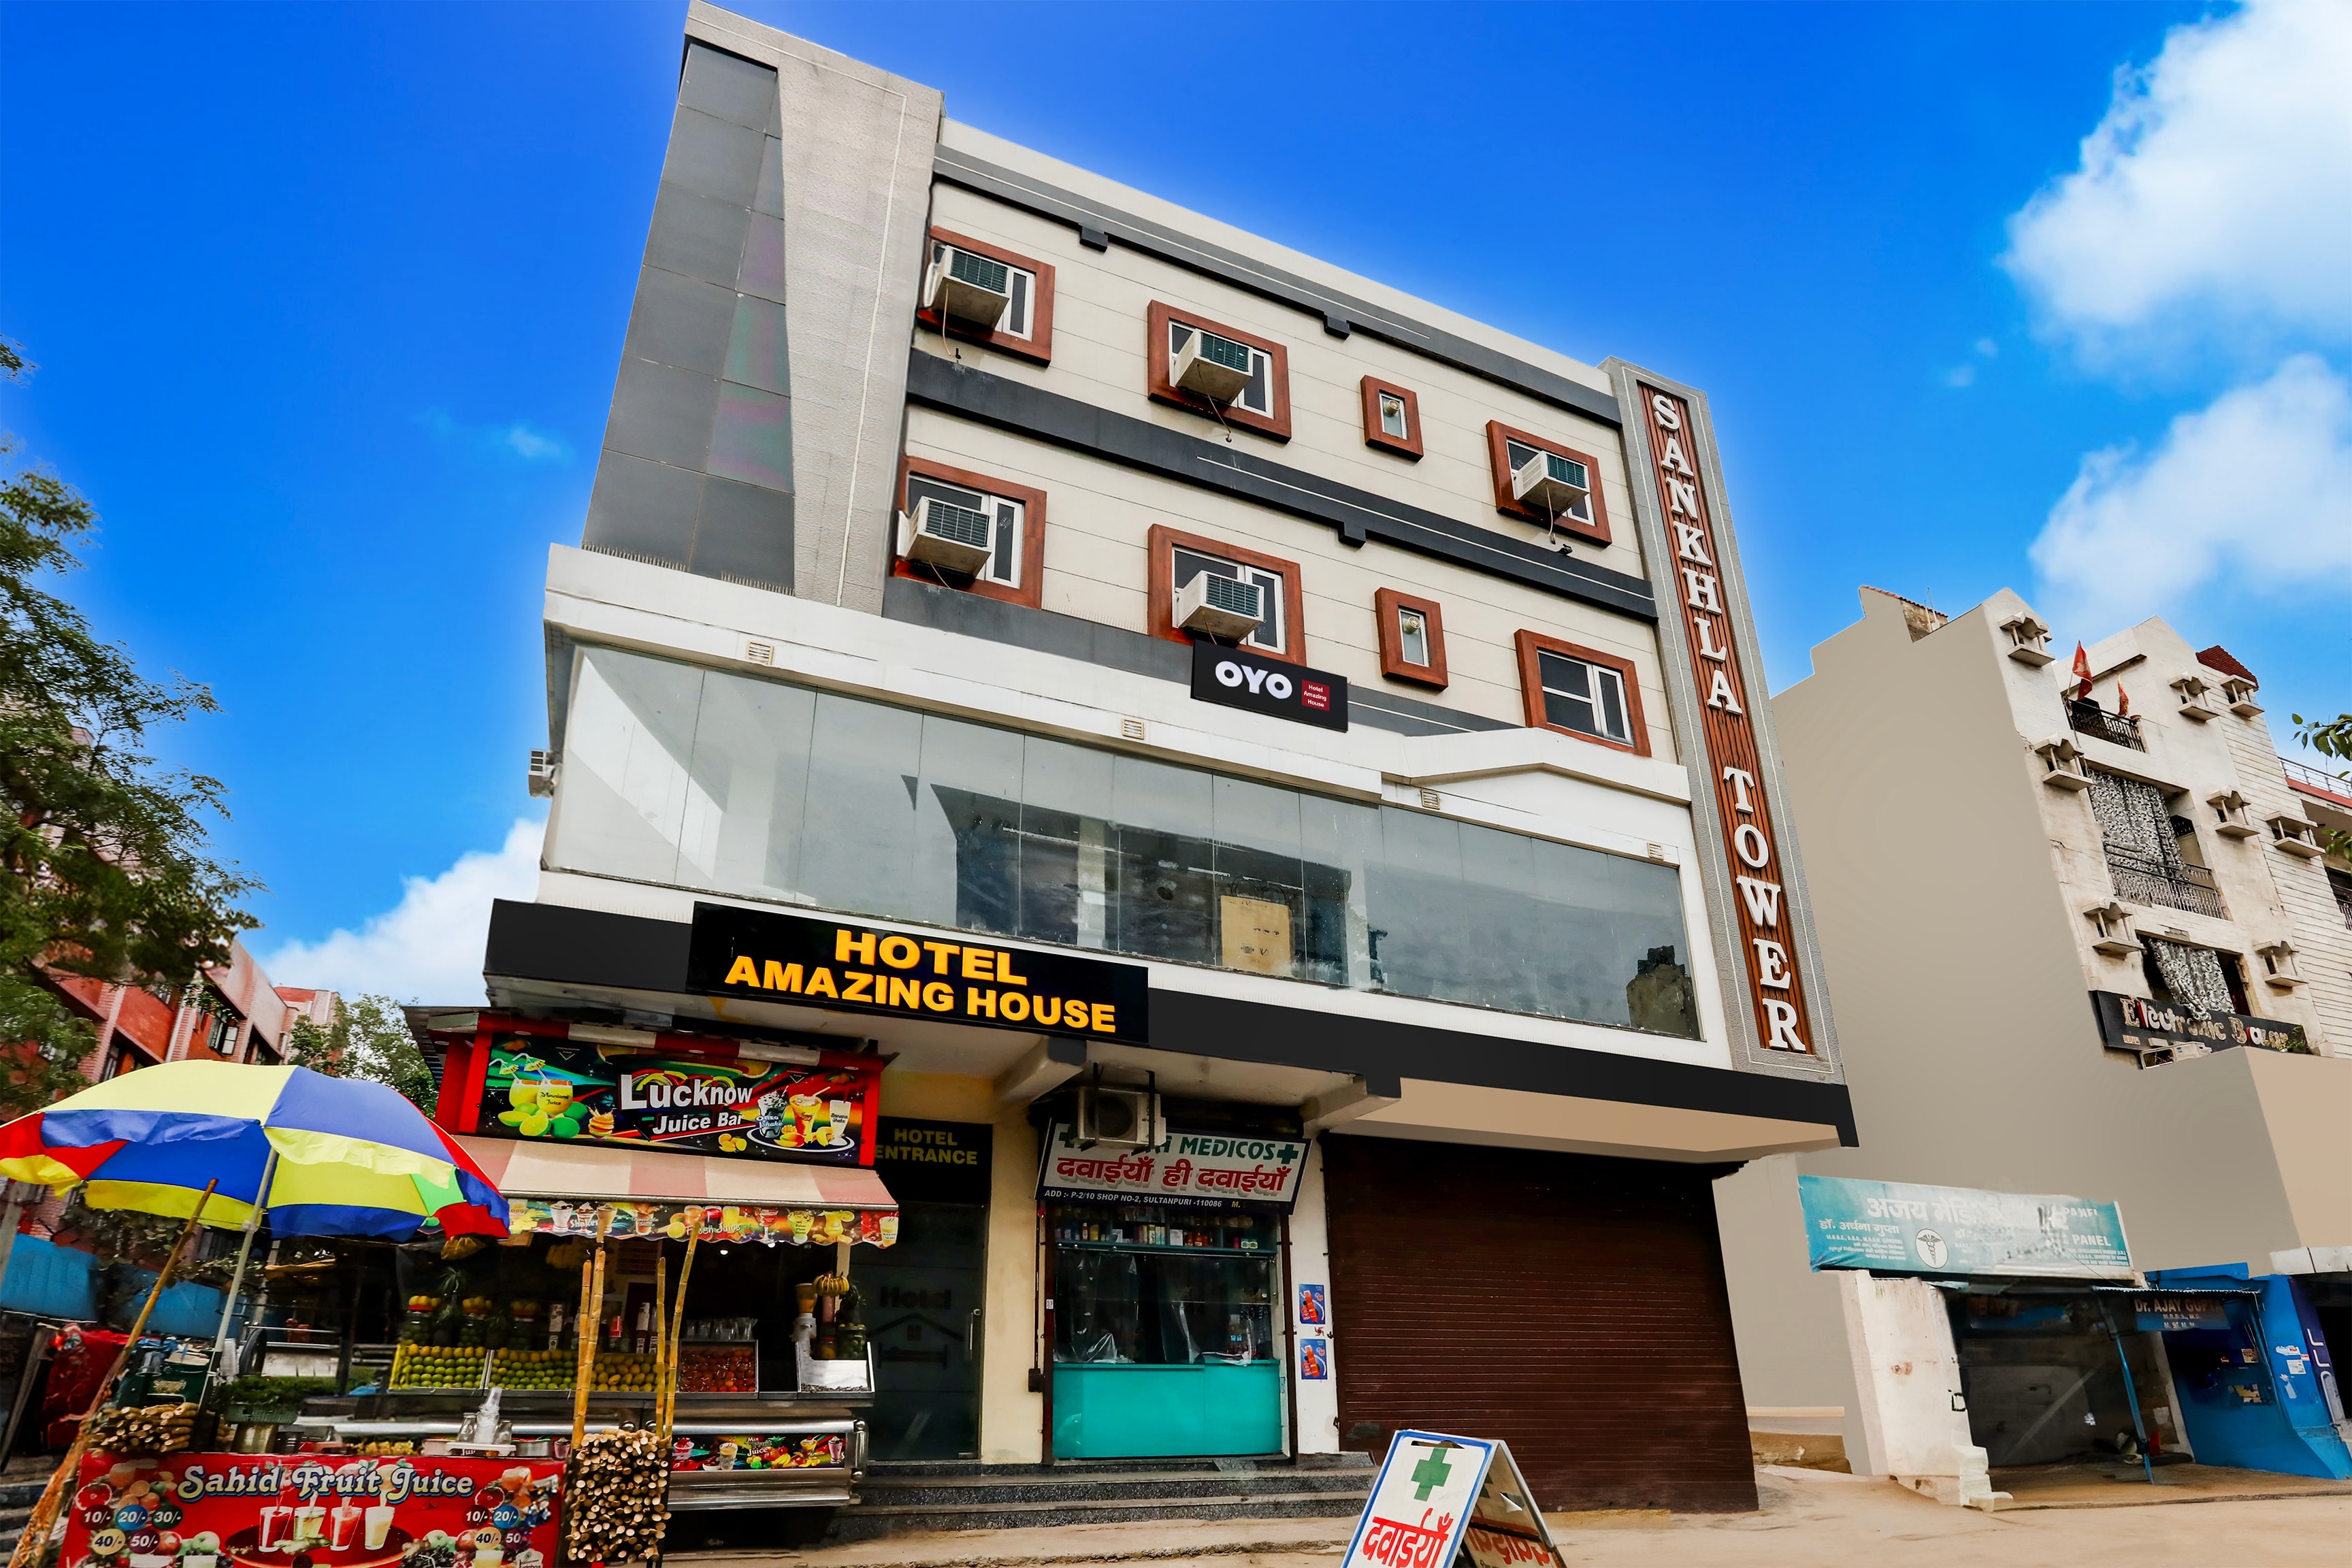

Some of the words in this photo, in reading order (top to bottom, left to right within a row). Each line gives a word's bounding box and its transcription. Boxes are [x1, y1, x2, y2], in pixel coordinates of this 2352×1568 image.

[1215, 661, 1292, 700] OYO
[1309, 684, 1323, 693] Hotel
[1303, 690, 1327, 702] Amazing
[1307, 699, 1324, 708] House
[1652, 394, 1742, 715] SANKHLA
[1723, 766, 1806, 1052] TOWER
[835, 930, 1028, 986] HOTEL
[724, 956, 954, 1012] AMAZING
[966, 987, 1116, 1033] HOUSE
[621, 1074, 753, 1110] Lucknow
[653, 1114, 710, 1134] Juice
[717, 1112, 743, 1127] Bar
[894, 1128, 958, 1146] HOTEL
[875, 1144, 977, 1165] ENTRANCE
[1179, 1137, 1276, 1160] MEDICOS
[1056, 1154, 1155, 1184] दवाईयाँ
[1162, 1158, 1193, 1186] ही
[1197, 1164, 1292, 1192] दवाईयाँ
[1071, 1192, 1095, 1200] P-2/10
[1096, 1193, 1119, 1201] SHOP
[1121, 1194, 1141, 1203] NO-2,
[1143, 1196, 1192, 1205] SULTANPURI
[1867, 1197, 1928, 1222] अजय
[685, 1224, 713, 1235] Fesh
[717, 1222, 741, 1233] Juice
[1818, 1218, 1836, 1230] डॉ.
[1840, 1220, 1871, 1232] अर्चना
[1874, 1224, 1900, 1237] गुप्ता
[2072, 1234, 2112, 1247] PANEL
[2134, 1298, 2151, 1312] Dr.
[2154, 1298, 2181, 1312] AJAY
[747, 1448, 768, 1456] Juice
[178, 1465, 282, 1502] Sahid
[291, 1465, 382, 1501] Fruit
[387, 1468, 474, 1503] Juice
[84, 1511, 111, 1524] 10/-
[118, 1511, 146, 1524] 20/-
[154, 1511, 182, 1524] 30/-
[466, 1511, 489, 1523] 10/-
[493, 1511, 517, 1524] 20/-
[95, 1535, 122, 1548] 40/-
[131, 1535, 158, 1548] 50/-
[476, 1533, 498, 1547] 40/-
